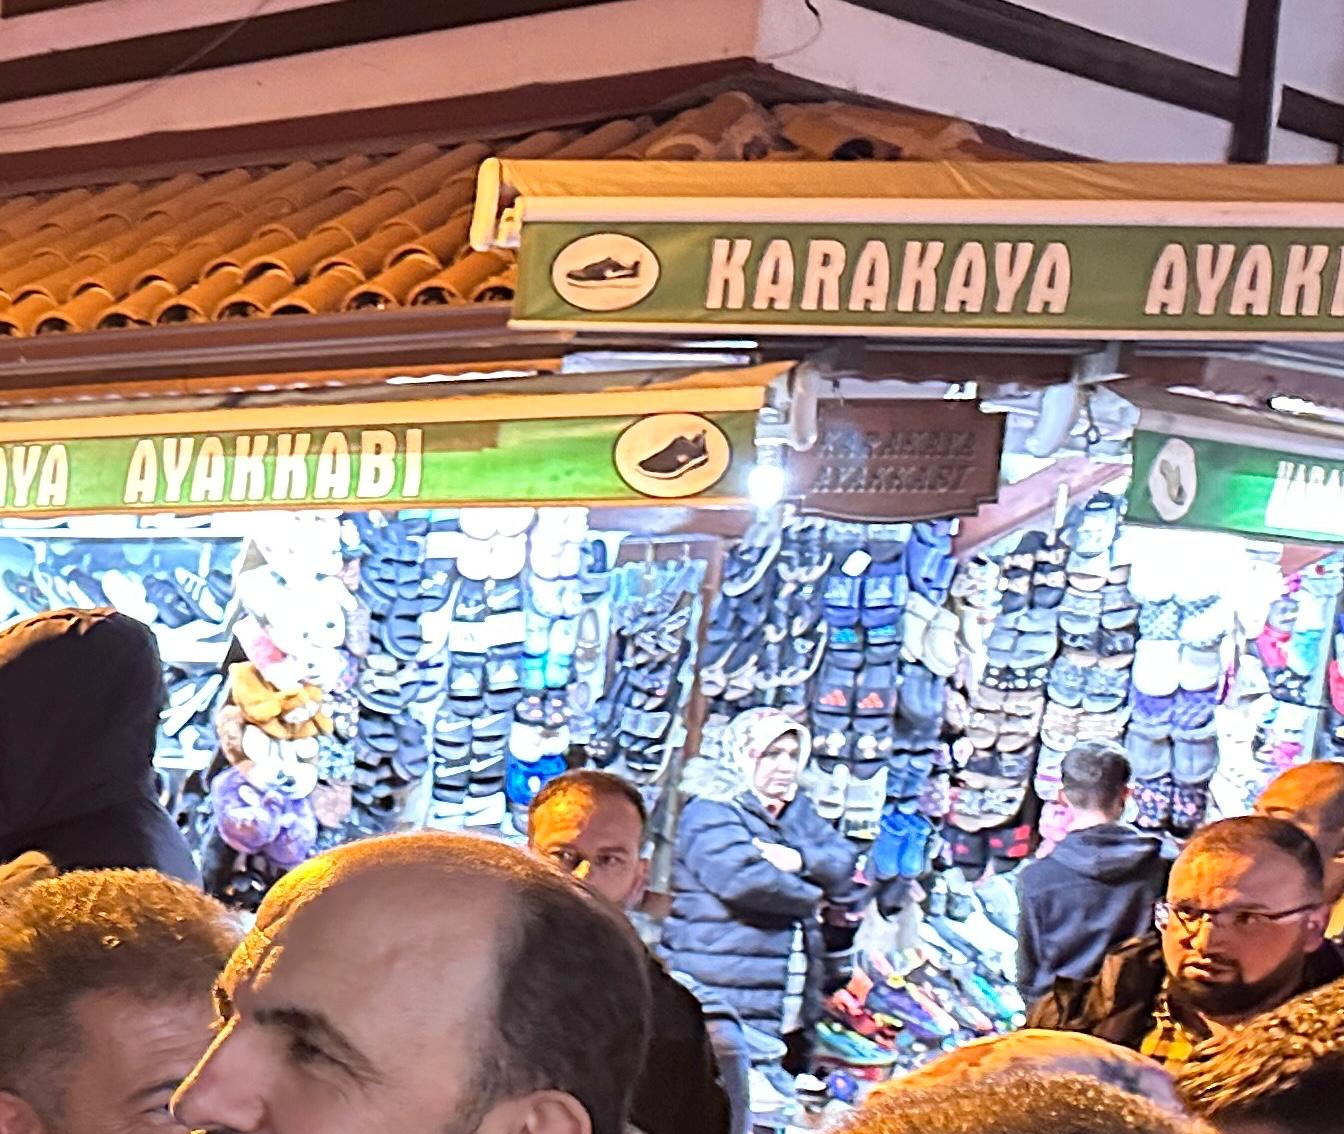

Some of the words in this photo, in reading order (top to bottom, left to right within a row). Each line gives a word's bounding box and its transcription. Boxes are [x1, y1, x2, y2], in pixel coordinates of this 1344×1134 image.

[705, 237, 1072, 314] KARAKAYA
[1144, 242, 1344, 317] AYAK
[123, 428, 423, 503] AYAKKABI
